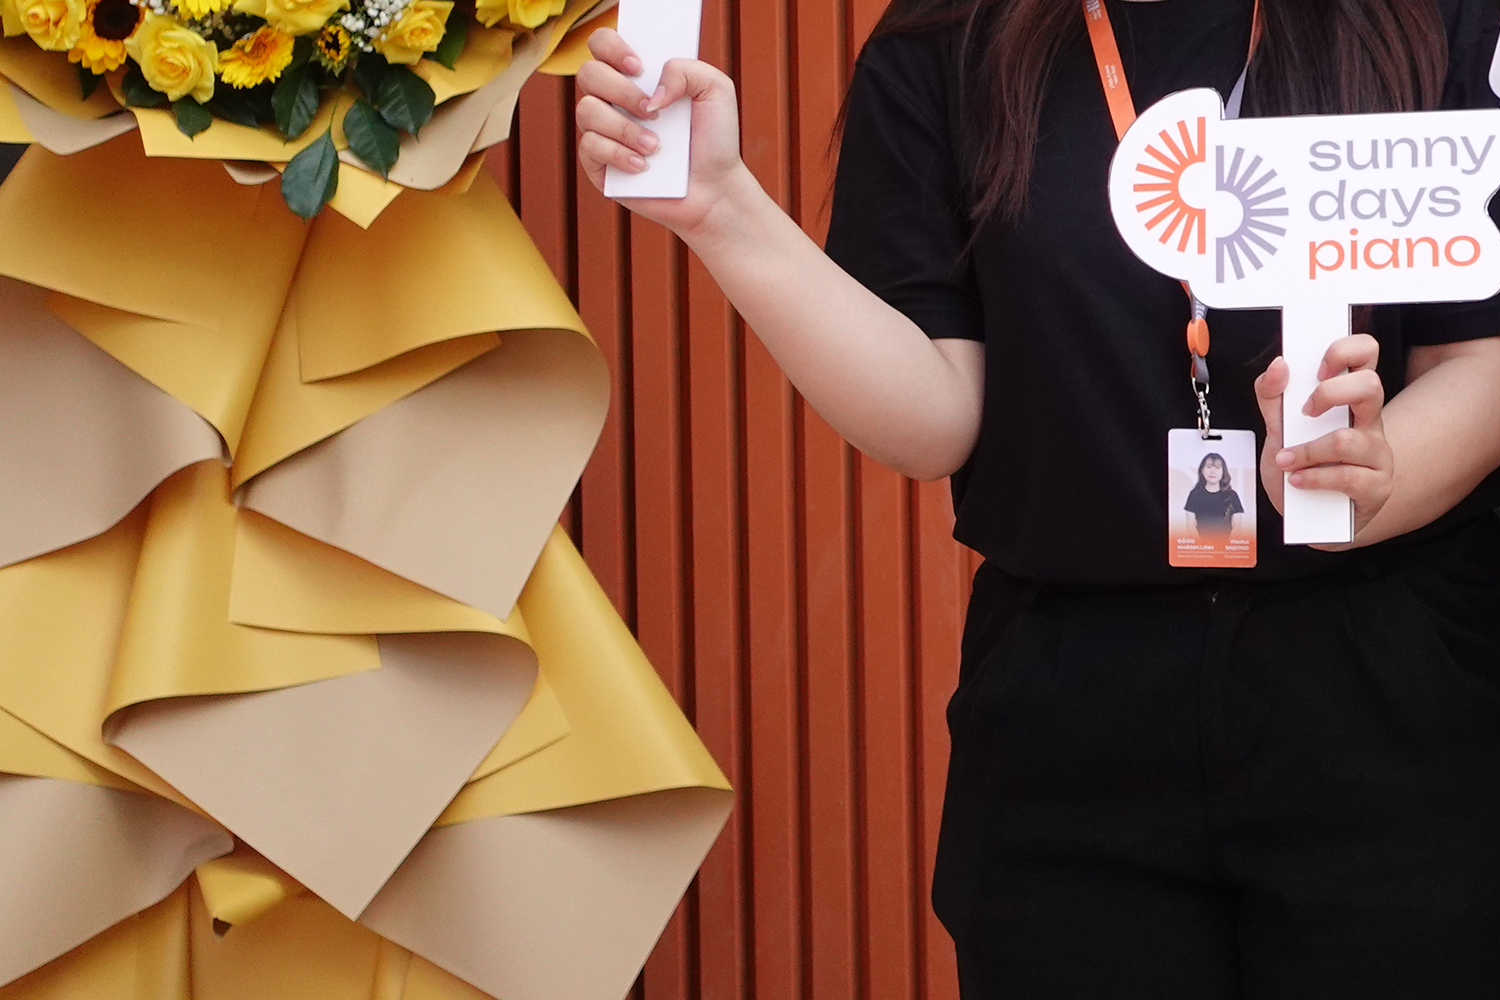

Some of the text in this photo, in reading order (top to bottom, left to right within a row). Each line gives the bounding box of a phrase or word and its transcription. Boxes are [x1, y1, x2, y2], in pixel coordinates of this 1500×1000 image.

[1308, 134, 1497, 176] sunny
[1308, 179, 1462, 228] days
[1308, 227, 1481, 280] piano
